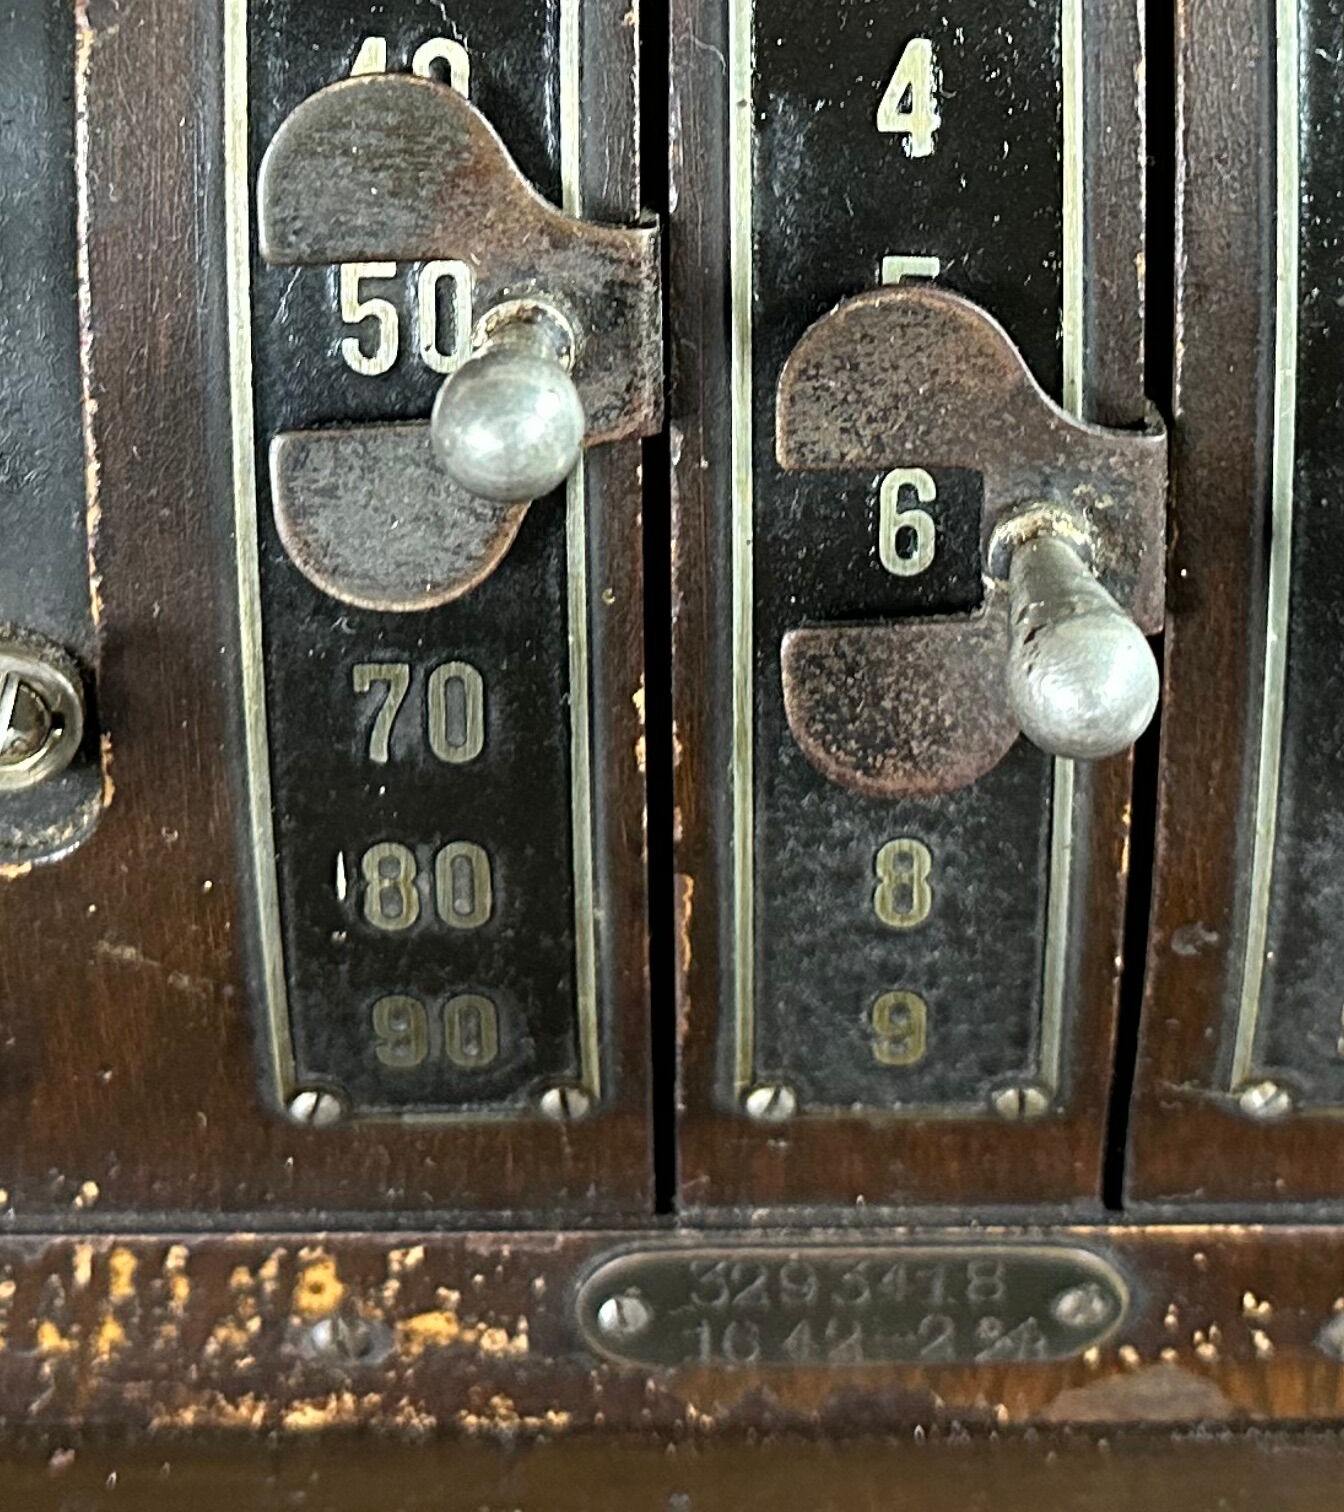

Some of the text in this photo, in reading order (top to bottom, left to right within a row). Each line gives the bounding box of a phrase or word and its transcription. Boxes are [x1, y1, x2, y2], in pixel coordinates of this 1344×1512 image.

[876, 37, 941, 159] 4
[340, 260, 473, 376] 50
[877, 468, 936, 577] 6
[353, 660, 483, 764] 70
[361, 841, 492, 930] 80
[872, 838, 932, 929] 8
[370, 992, 500, 1069] 90
[871, 991, 929, 1065] 9
